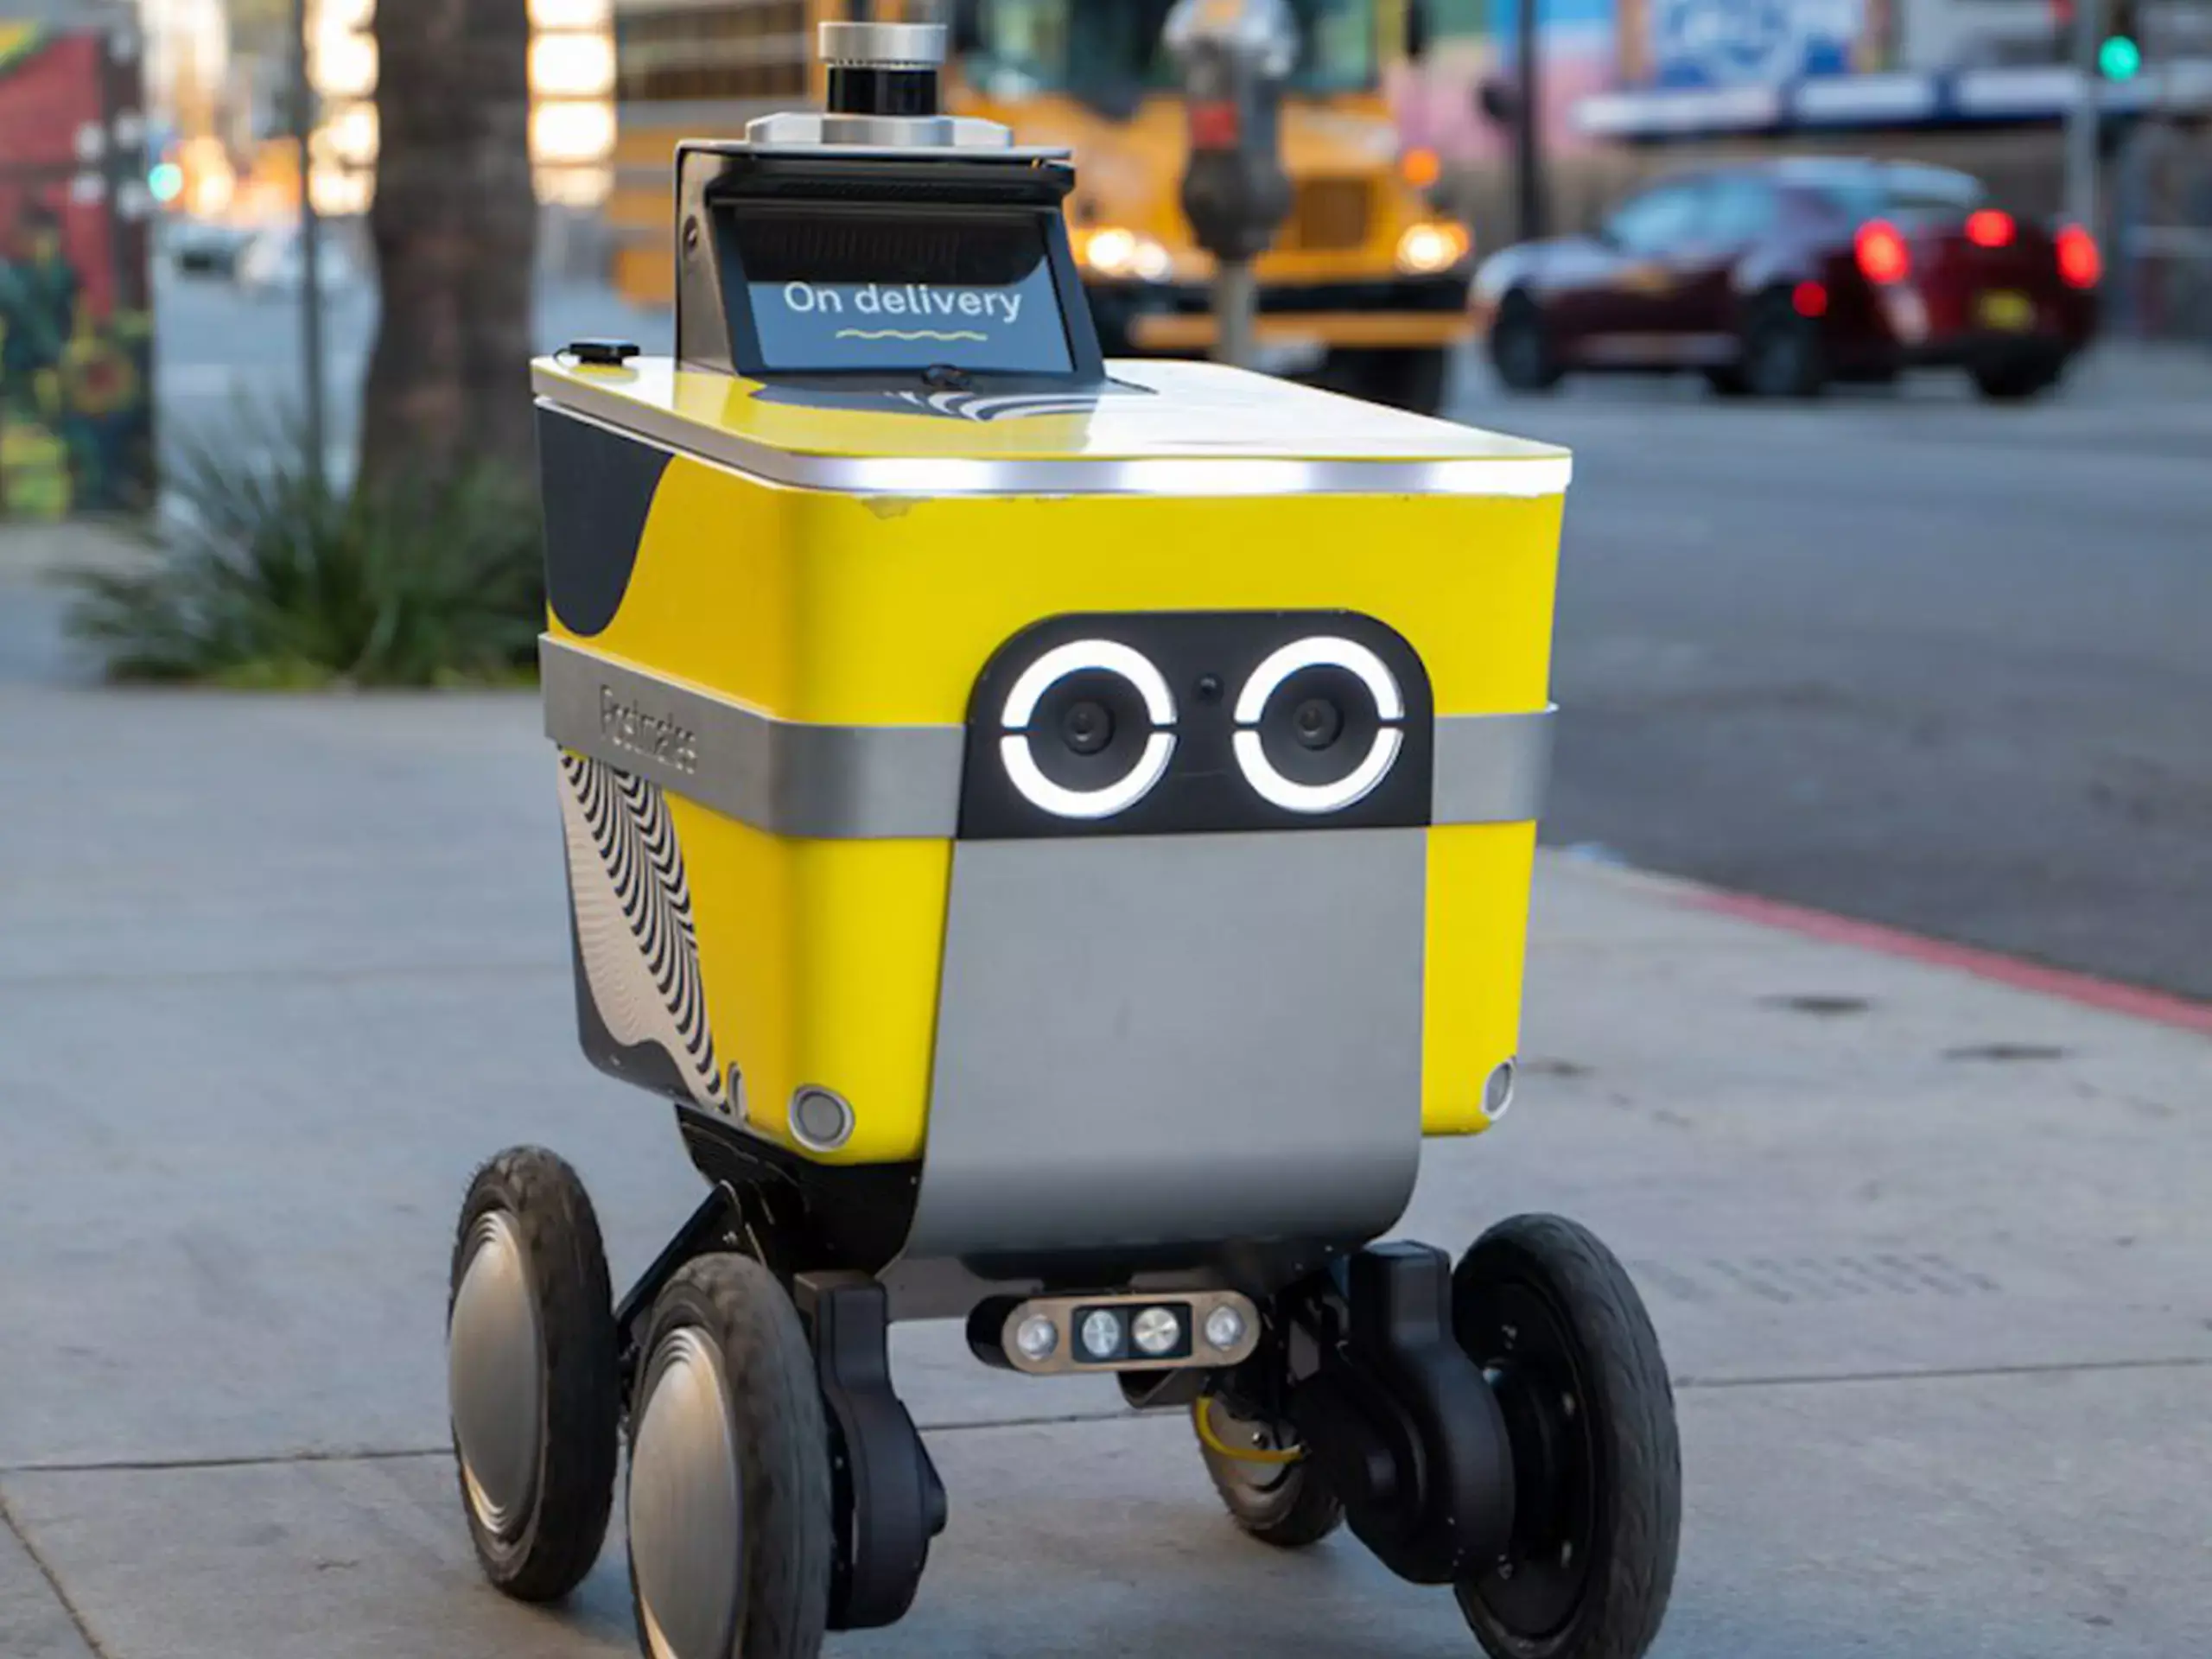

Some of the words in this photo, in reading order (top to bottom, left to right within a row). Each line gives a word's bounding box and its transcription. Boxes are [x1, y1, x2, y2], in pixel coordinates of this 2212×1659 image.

[784, 281, 842, 312] On
[854, 283, 1021, 323] delivery
[600, 684, 696, 774] Postmates
